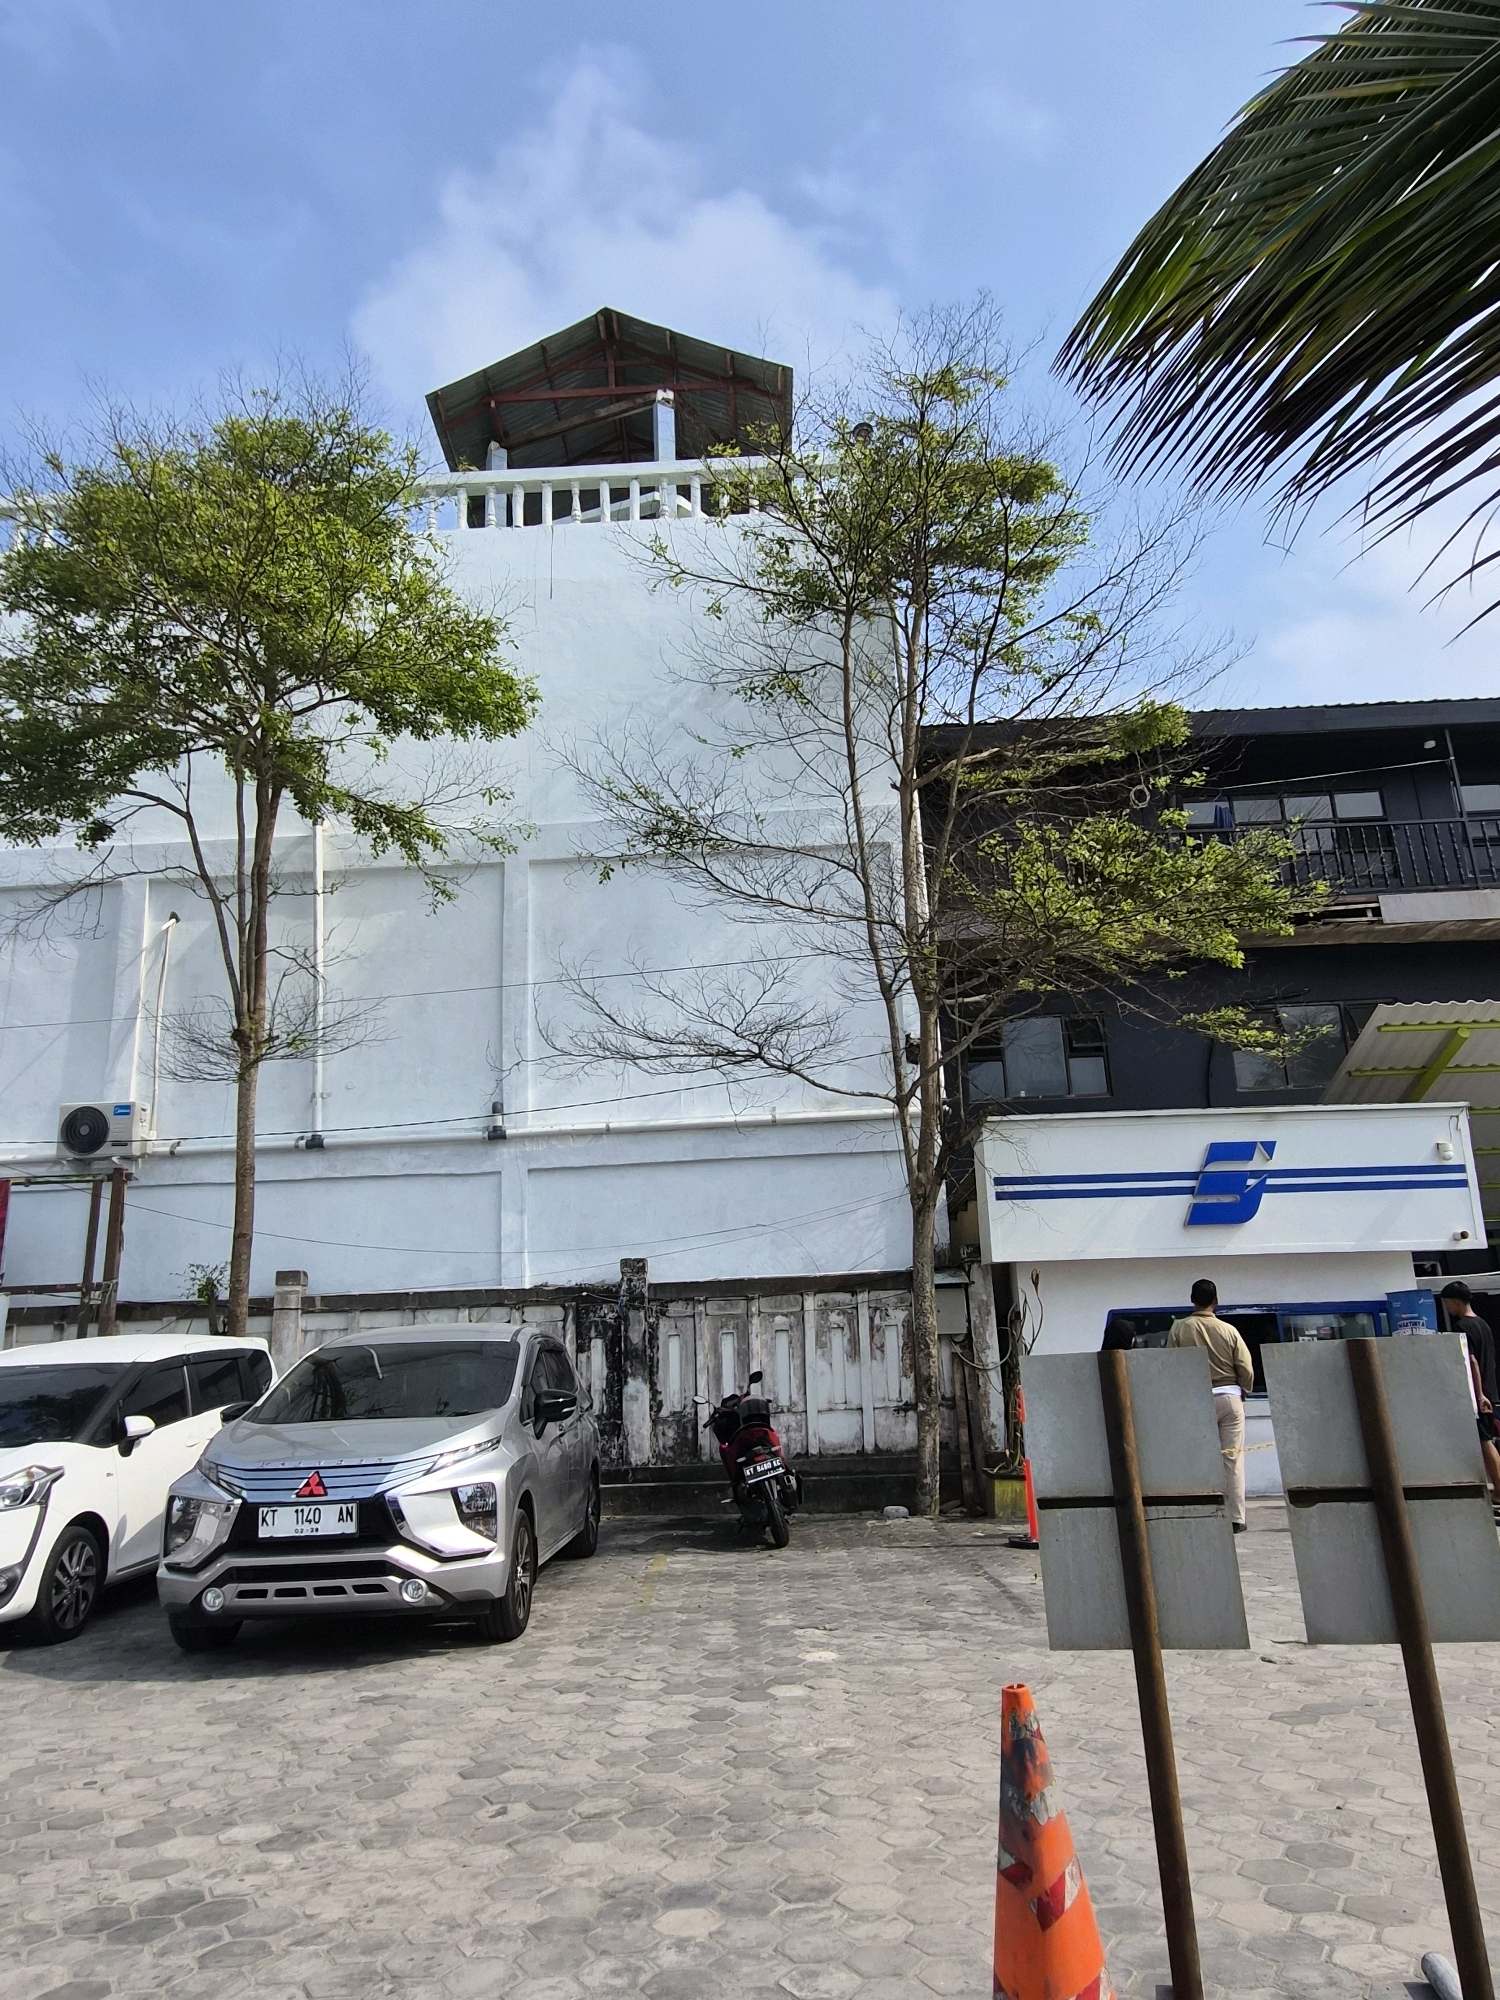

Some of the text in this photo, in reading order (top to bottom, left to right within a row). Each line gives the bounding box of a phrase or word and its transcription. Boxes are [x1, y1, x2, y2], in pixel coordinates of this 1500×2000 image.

[261, 1505, 353, 1527] KT 1140 AN
